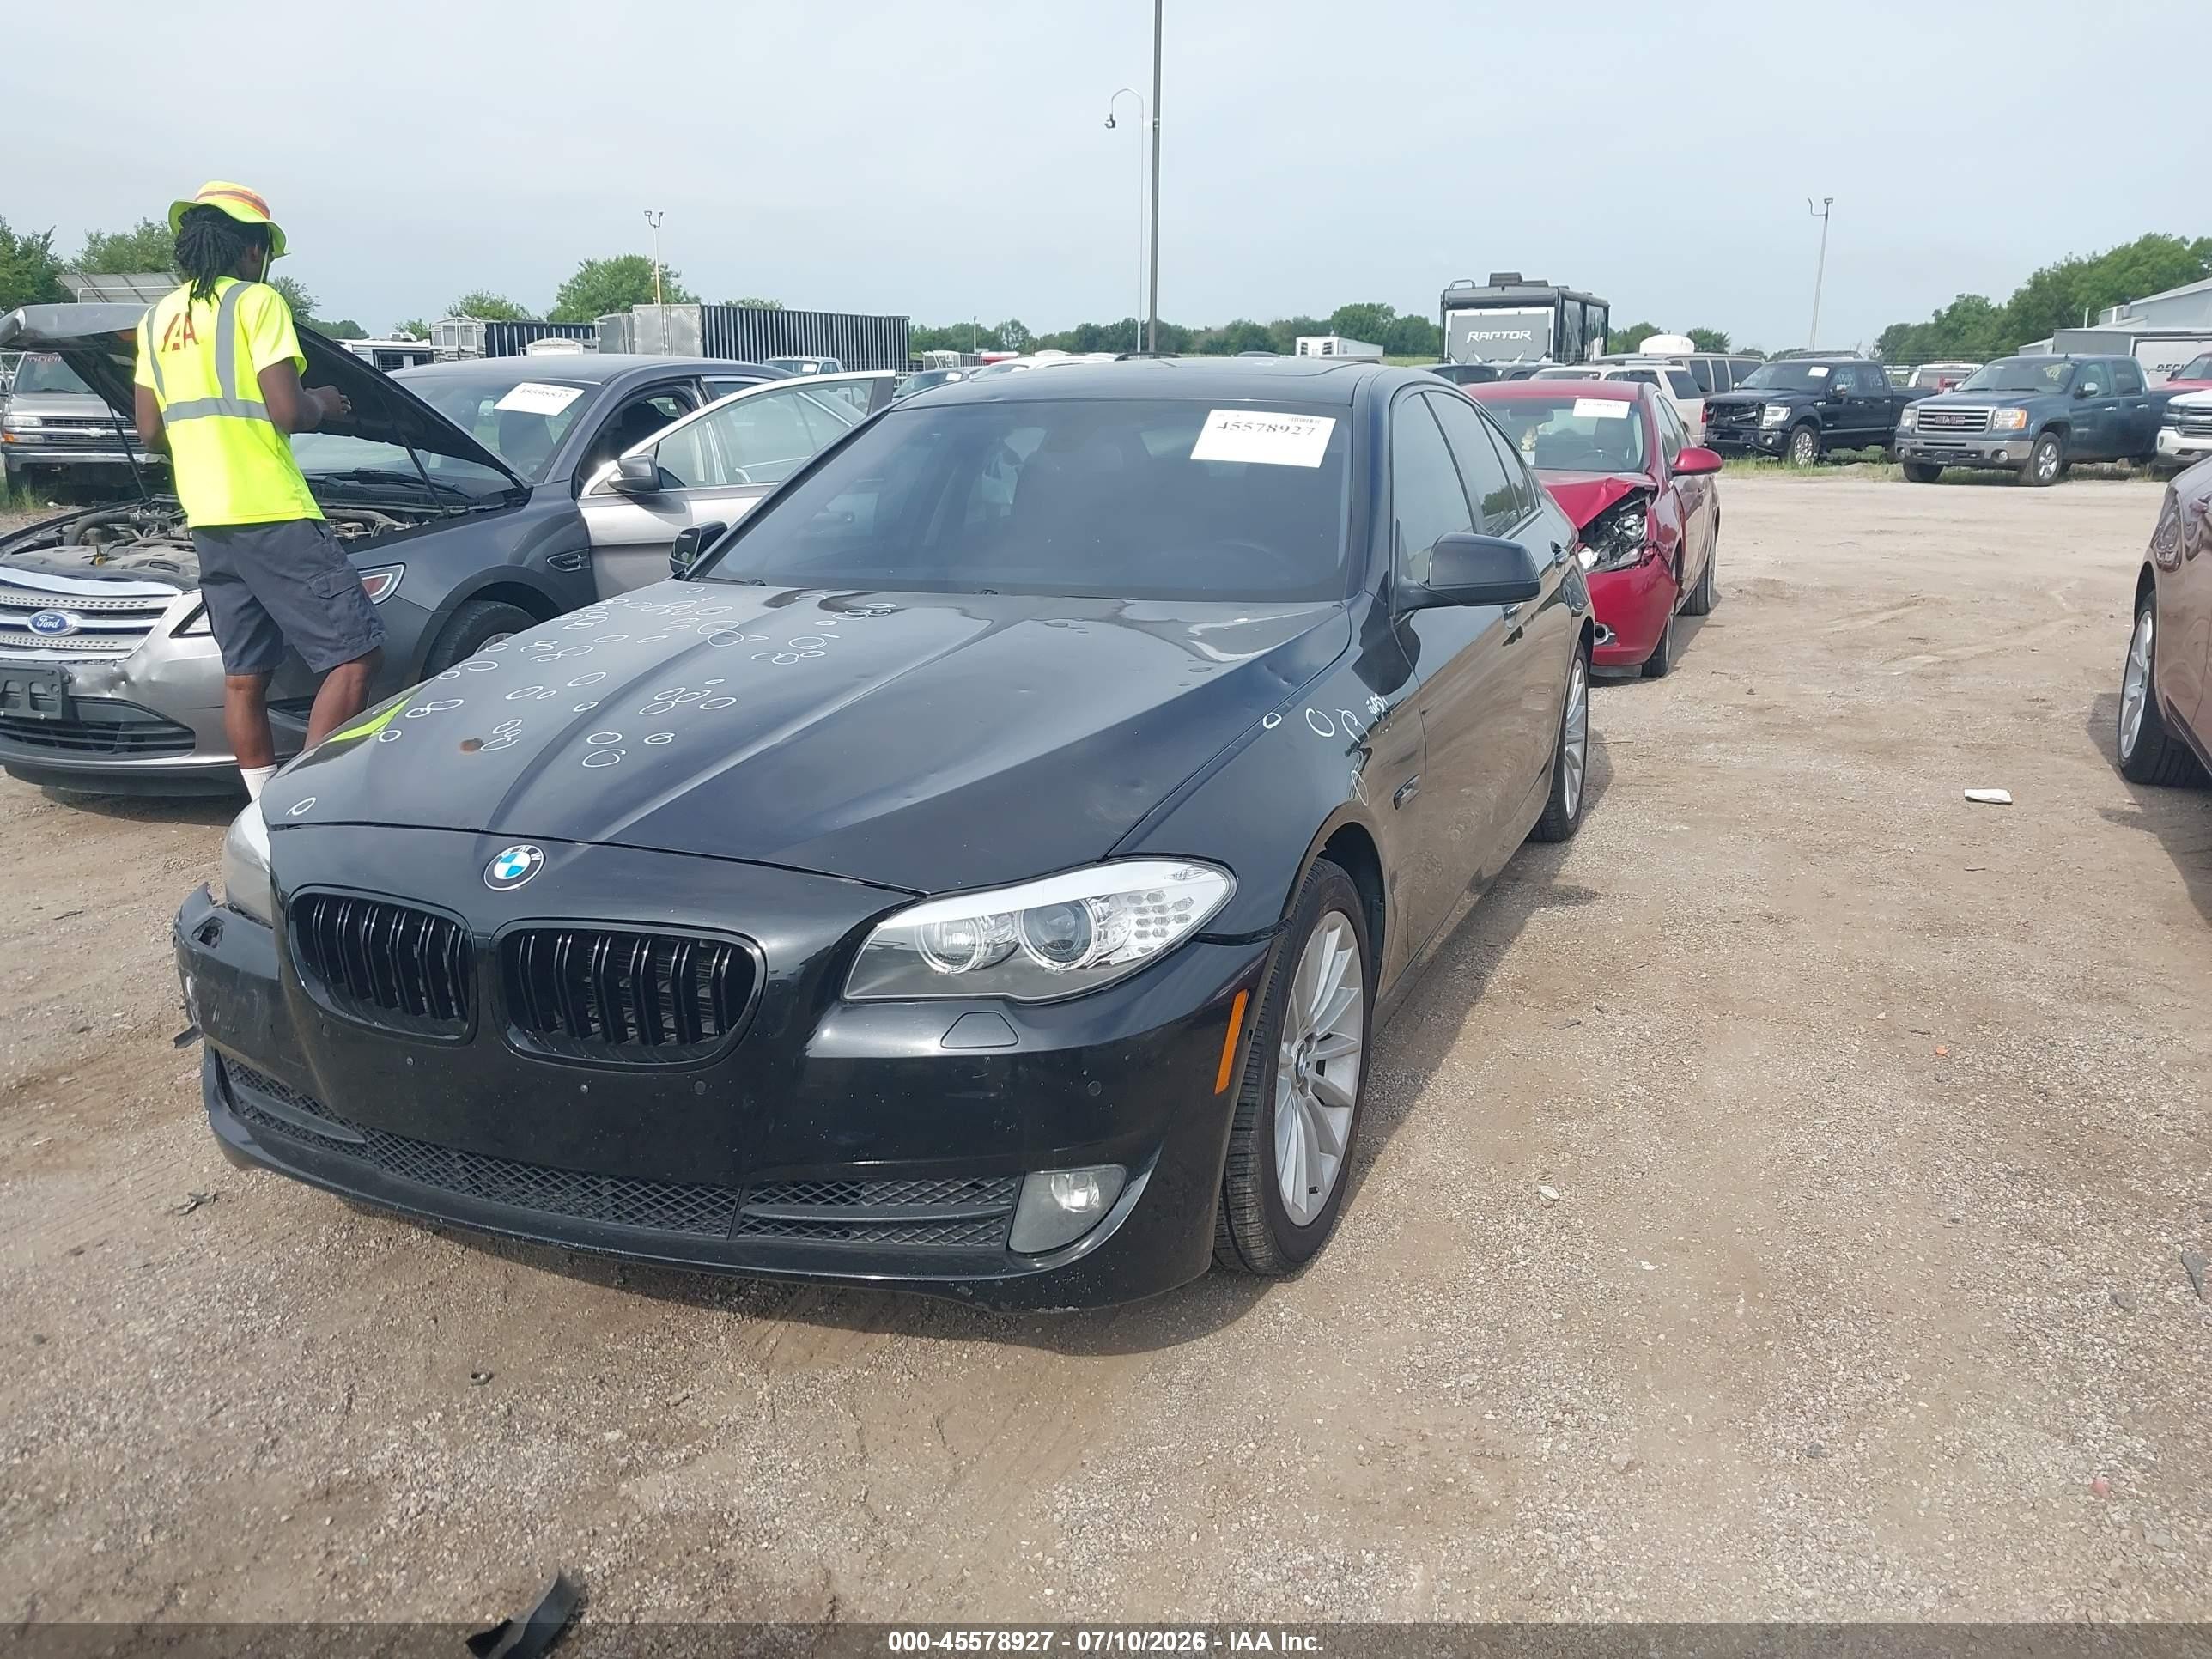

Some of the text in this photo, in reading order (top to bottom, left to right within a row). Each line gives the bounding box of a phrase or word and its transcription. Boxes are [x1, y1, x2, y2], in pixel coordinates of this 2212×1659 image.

[1466, 330, 1533, 344] RAPTOR
[1934, 416, 1966, 426] GMC
[1216, 421, 1316, 436] 45578927
[37, 615, 60, 628] Ford
